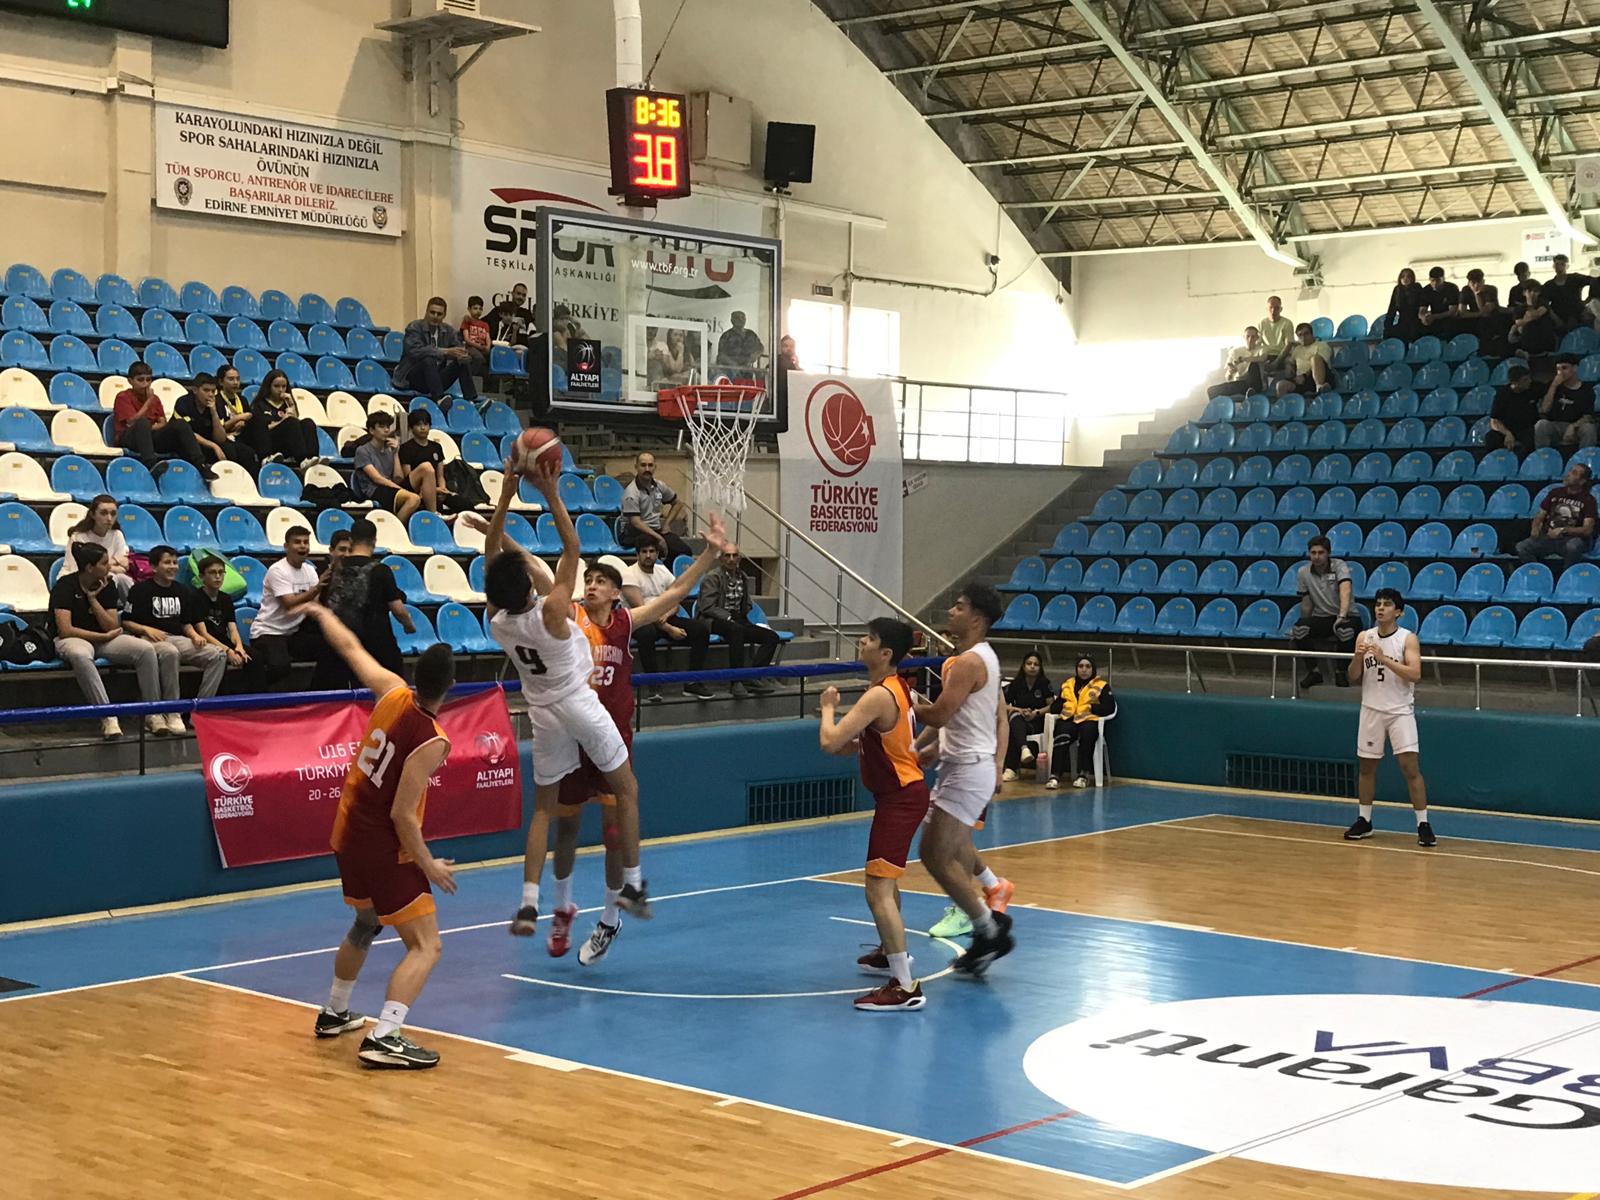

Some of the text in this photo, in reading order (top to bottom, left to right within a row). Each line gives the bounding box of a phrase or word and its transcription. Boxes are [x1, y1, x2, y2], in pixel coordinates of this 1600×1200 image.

[636, 96, 681, 128] 8:36
[175, 112, 383, 155] KARAYOLUNDAKİ HIZINIZLA DEĞİL
[180, 130, 379, 171] SPOR SAHALARINDAKİ HIZINIZLA
[257, 157, 310, 177] ÖVÜNÜN
[165, 162, 190, 176] TÜM
[247, 174, 307, 192] ANTRENÖR
[310, 183, 323, 194] VE
[230, 187, 291, 204] BAŞARILAR
[205, 198, 368, 228] EDİRNE EMNİYET MÜDÜRLÜĞÜ
[486, 257, 616, 282] TEŞKİLA AŞKANLIĞI
[631, 259, 699, 278] www.tbf.org.tr
[570, 373, 599, 382] ALTYAPI
[811, 480, 878, 505] TÜRKİYE
[810, 504, 878, 520] BASKETBOL
[810, 520, 878, 533] FEDERASYONU
[161, 597, 181, 615] NBA
[515, 645, 547, 675] 9
[591, 665, 615, 686] 23
[1377, 668, 1385, 681] 5
[319, 743, 347, 760] U16
[357, 728, 395, 788] 21
[477, 768, 514, 780] ALTYAPI
[214, 793, 253, 807] TÜRKİYE
[309, 789, 321, 800] 20
[329, 787, 341, 799] 26
